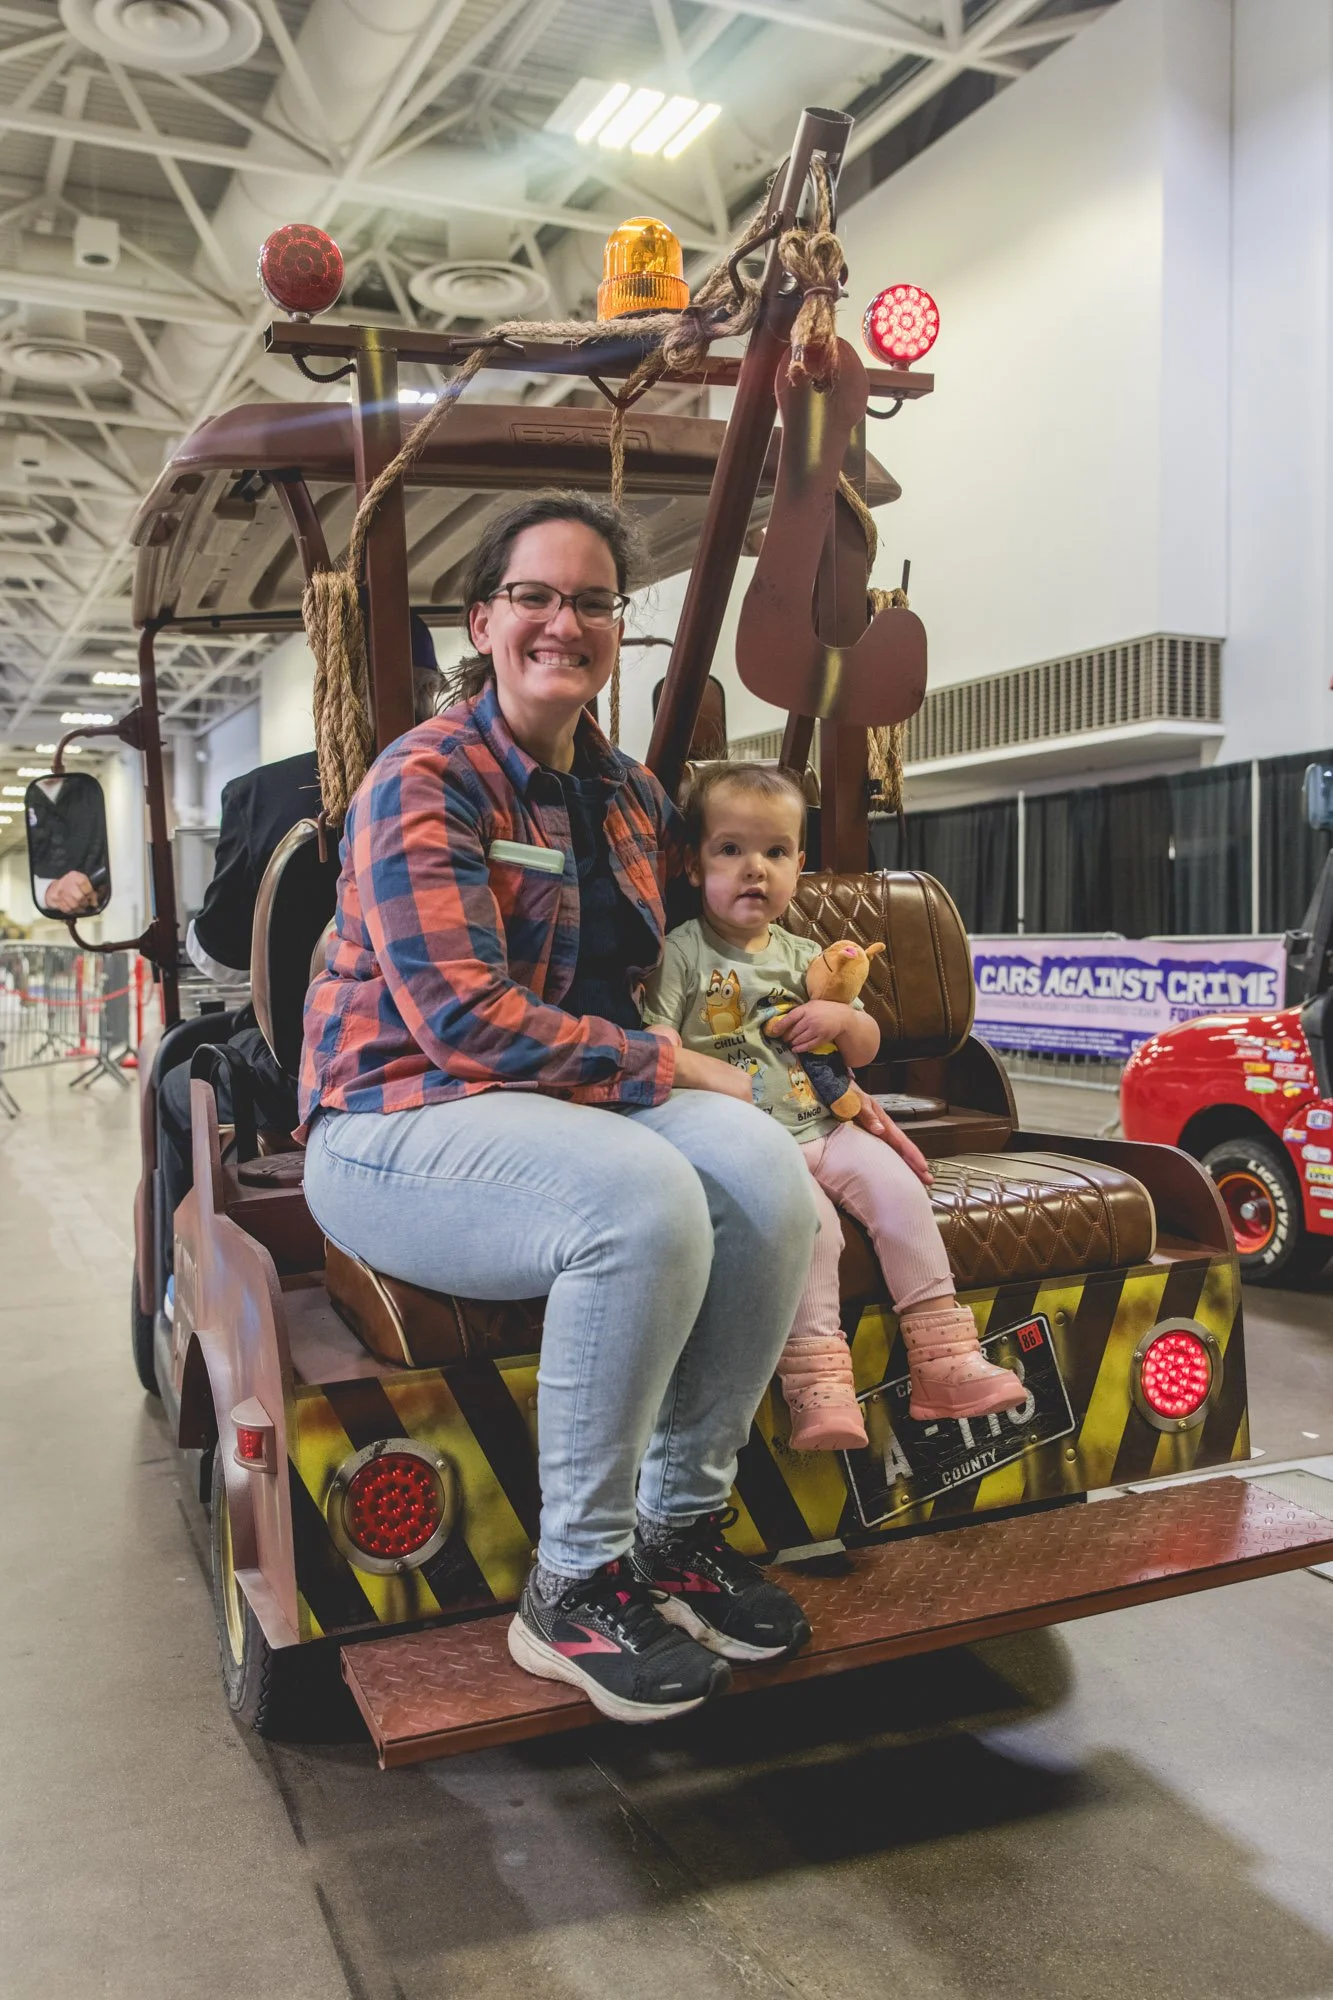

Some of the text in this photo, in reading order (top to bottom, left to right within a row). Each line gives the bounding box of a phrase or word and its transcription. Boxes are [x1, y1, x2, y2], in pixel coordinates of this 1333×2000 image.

[979, 964, 1278, 1006] CARS AGAINST CRIME
[713, 1035, 747, 1050] CHILLI
[797, 1106, 822, 1121] BINGO
[1020, 1330, 1038, 1350] 86
[941, 1448, 998, 1486] COUNTY
